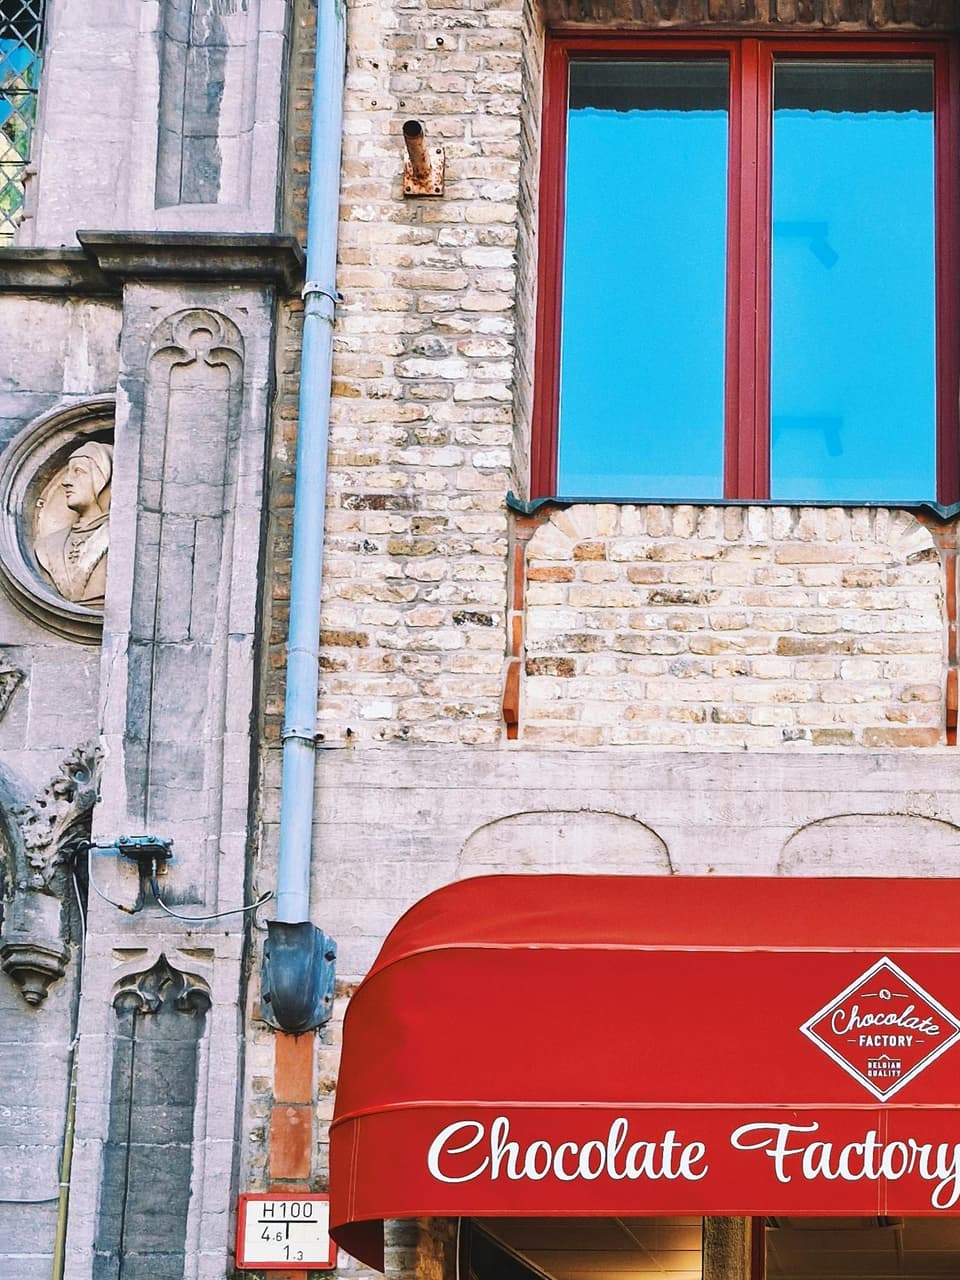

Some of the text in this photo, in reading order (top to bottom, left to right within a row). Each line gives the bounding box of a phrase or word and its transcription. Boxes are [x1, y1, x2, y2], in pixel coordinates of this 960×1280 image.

[831, 1004, 940, 1035] Chocolate
[859, 1035, 913, 1047] FACTORY
[427, 1116, 709, 1183] Chocolate
